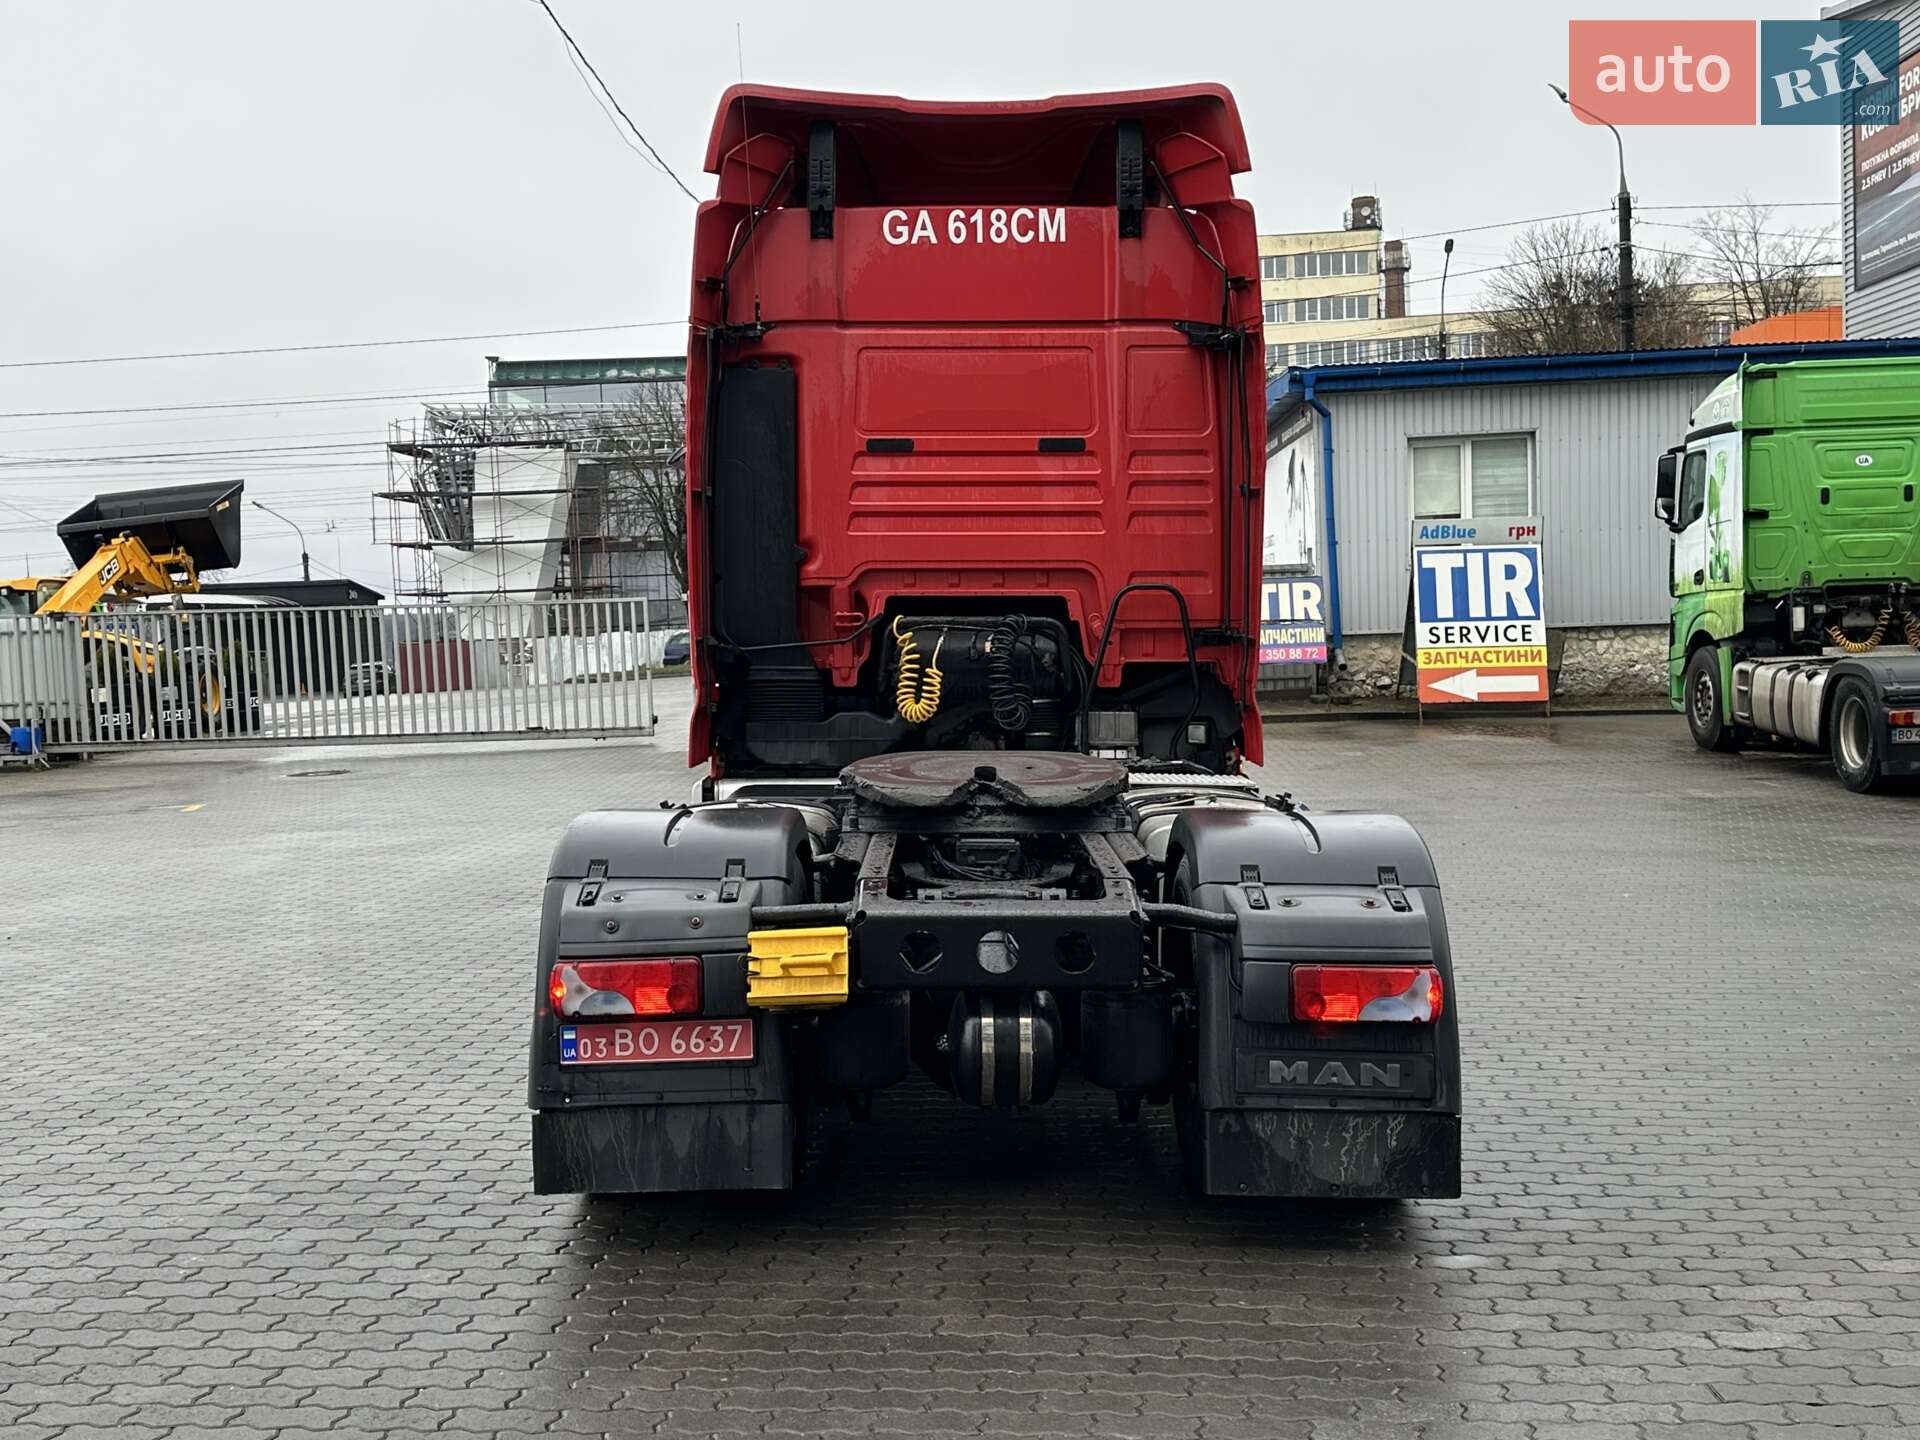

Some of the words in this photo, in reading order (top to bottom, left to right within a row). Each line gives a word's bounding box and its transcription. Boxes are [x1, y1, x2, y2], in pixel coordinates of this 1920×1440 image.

[882, 209, 938, 246] GA
[947, 207, 1066, 244] 618CM
[1420, 524, 1477, 540] AdBlue
[1508, 525, 1537, 541] грн
[99, 557, 121, 586] JCB
[1421, 550, 1537, 619] TIR
[1261, 582, 1323, 620] TIR
[1428, 624, 1534, 644] SERVICE
[1265, 648, 1287, 660] 350
[1289, 647, 1303, 660] 88
[1304, 646, 1320, 660] 72
[1422, 648, 1544, 666] ЗАПЧАСТИНИ
[563, 1048, 577, 1058] UA
[579, 1037, 607, 1059] 03
[614, 1027, 660, 1057] BO
[670, 1024, 743, 1055] 6637
[1268, 1059, 1401, 1088] MAN
